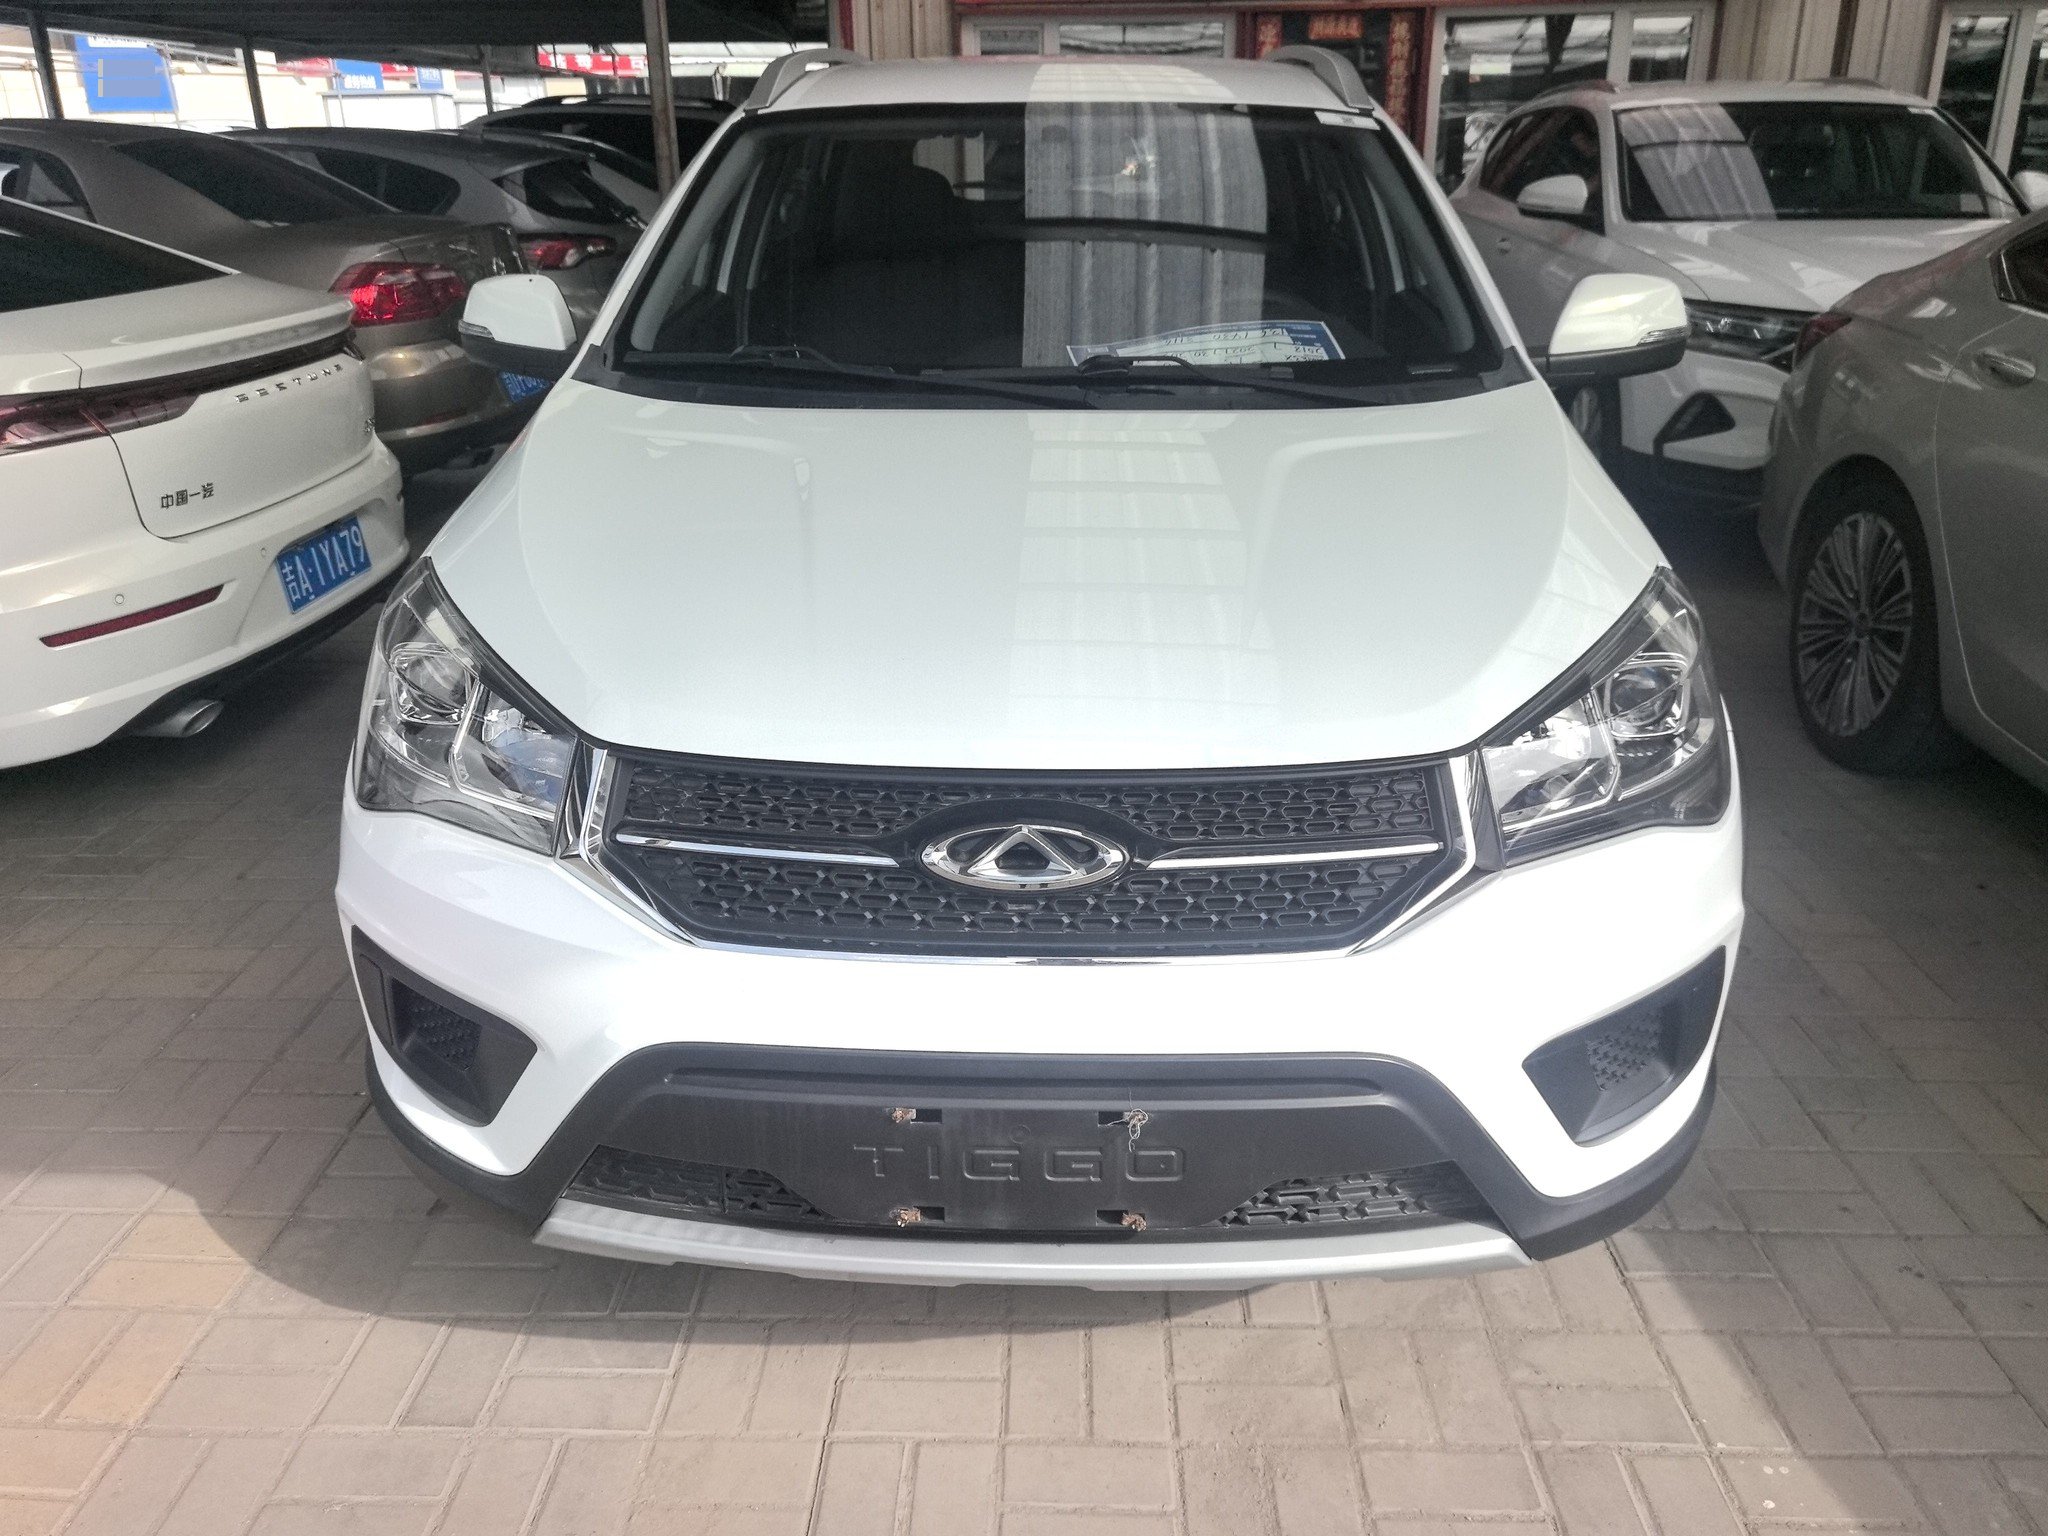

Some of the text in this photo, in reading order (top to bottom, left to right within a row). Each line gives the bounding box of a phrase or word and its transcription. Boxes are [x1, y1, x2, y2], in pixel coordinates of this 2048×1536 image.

[161, 482, 215, 509] 中国一汽
[853, 1144, 1185, 1182] TIGGO
